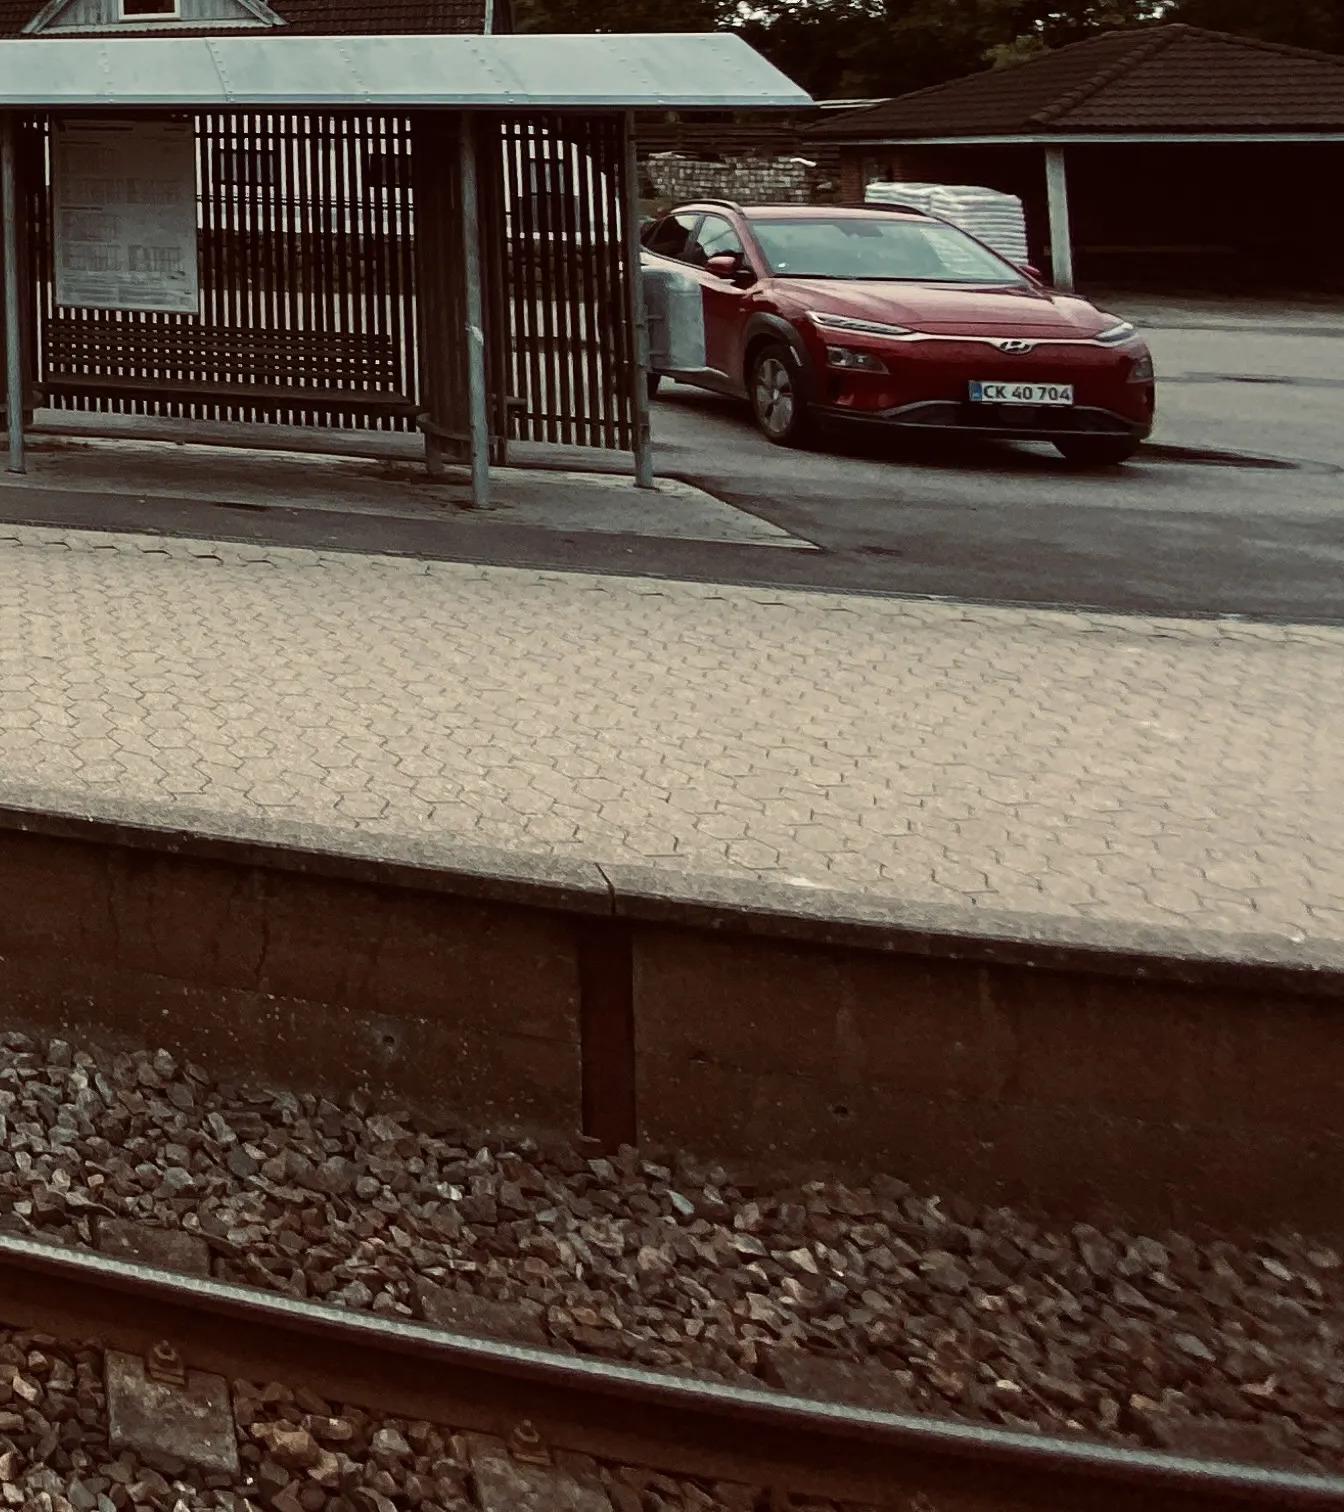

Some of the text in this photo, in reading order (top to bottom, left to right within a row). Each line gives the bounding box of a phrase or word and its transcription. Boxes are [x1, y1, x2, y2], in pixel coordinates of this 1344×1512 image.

[983, 385, 1071, 401] CK 40 704
